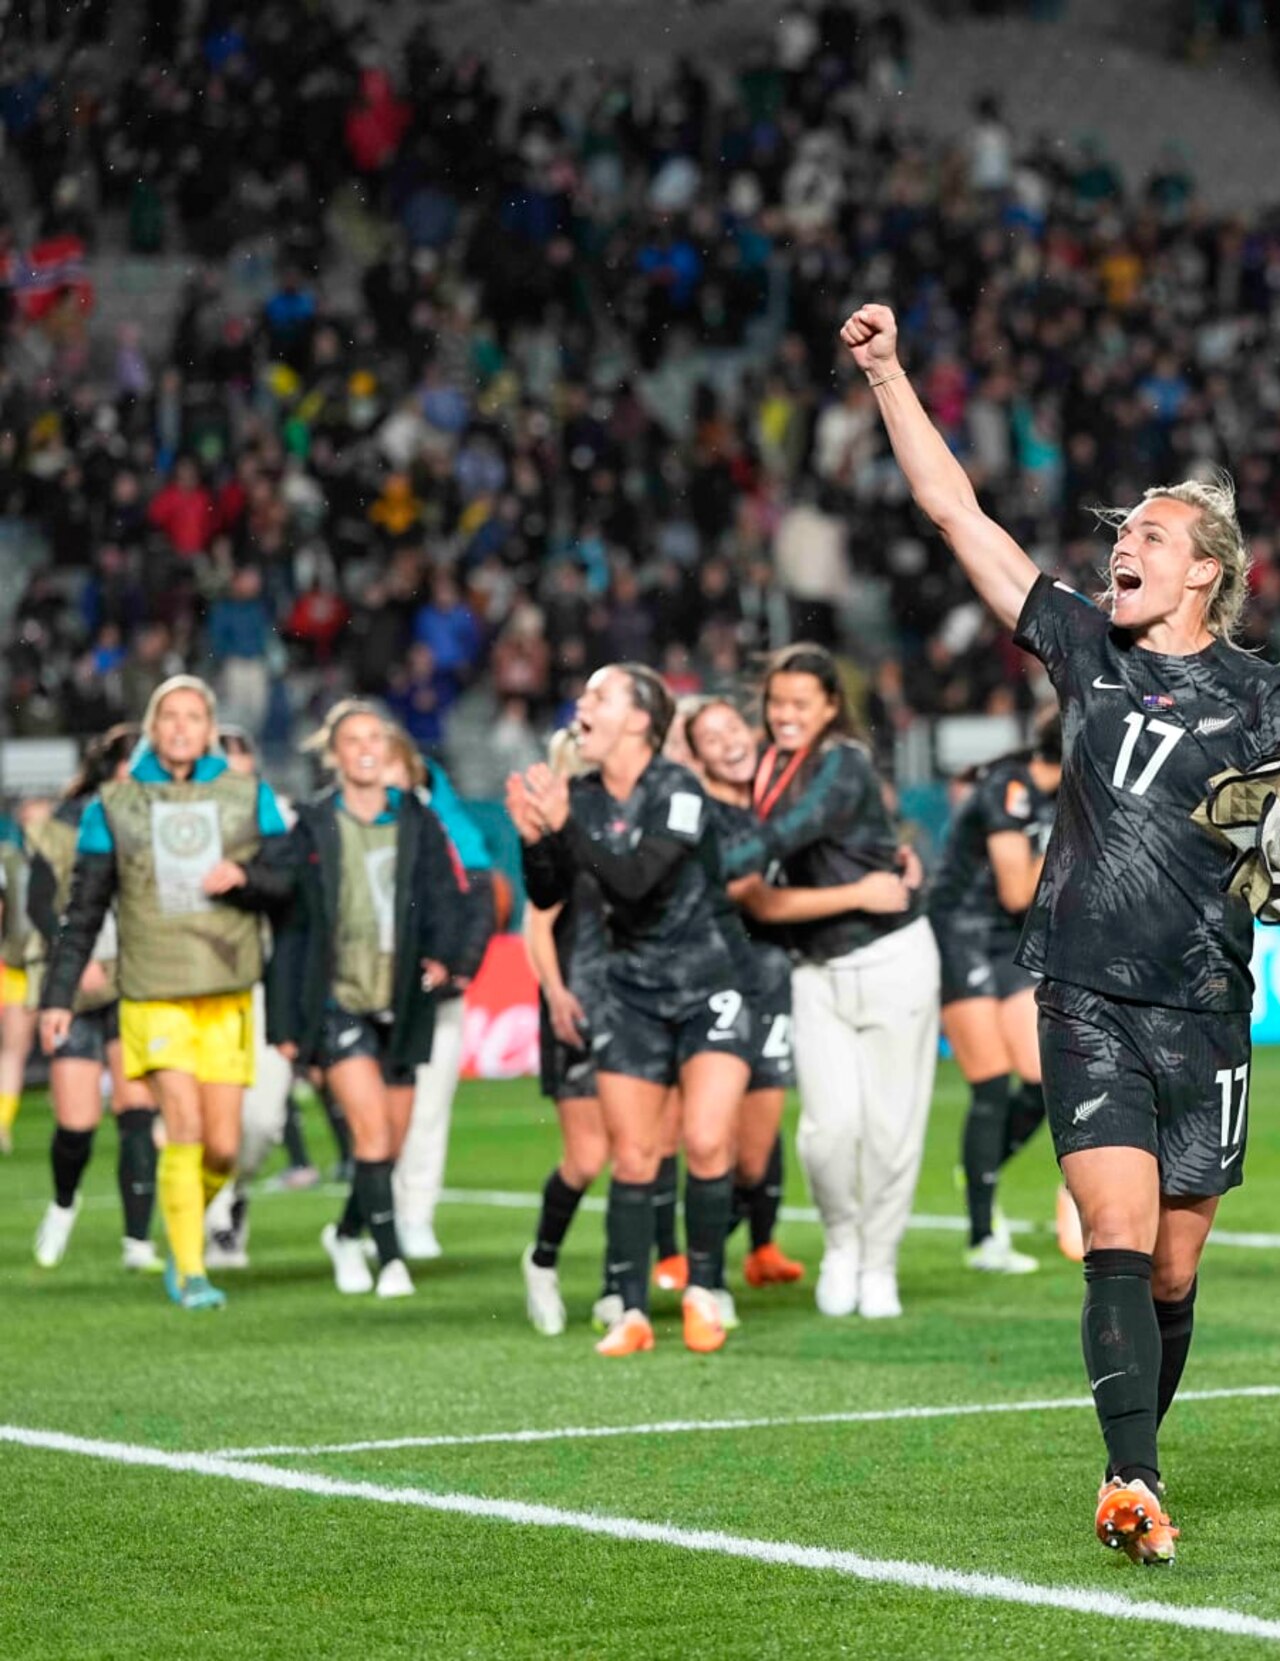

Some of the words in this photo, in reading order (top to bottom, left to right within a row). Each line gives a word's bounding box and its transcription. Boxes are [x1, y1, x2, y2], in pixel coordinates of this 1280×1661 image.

[1112, 711, 1186, 796] 17
[708, 989, 743, 1030] 9
[1215, 1062, 1248, 1147] 17
